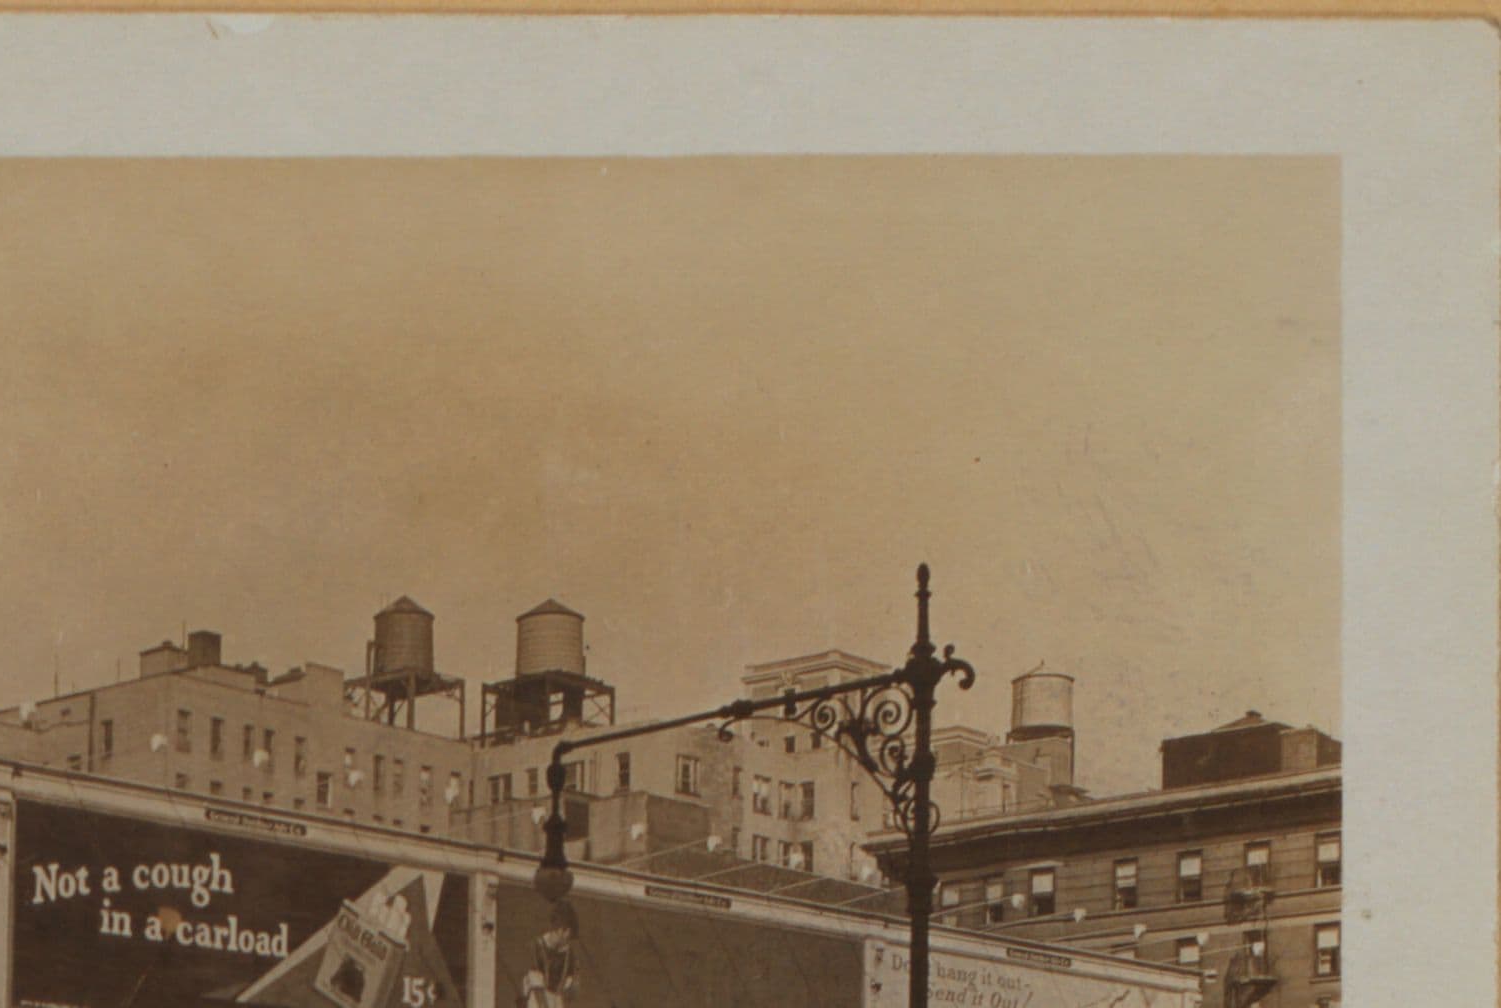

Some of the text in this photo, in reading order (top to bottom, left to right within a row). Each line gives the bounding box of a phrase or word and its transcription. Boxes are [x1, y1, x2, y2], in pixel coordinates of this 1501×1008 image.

[32, 852, 235, 909] Not a cough
[98, 897, 290, 959] in a carload
[936, 961, 978, 986] hang
[981, 966, 992, 986] it
[971, 991, 984, 1007] it
